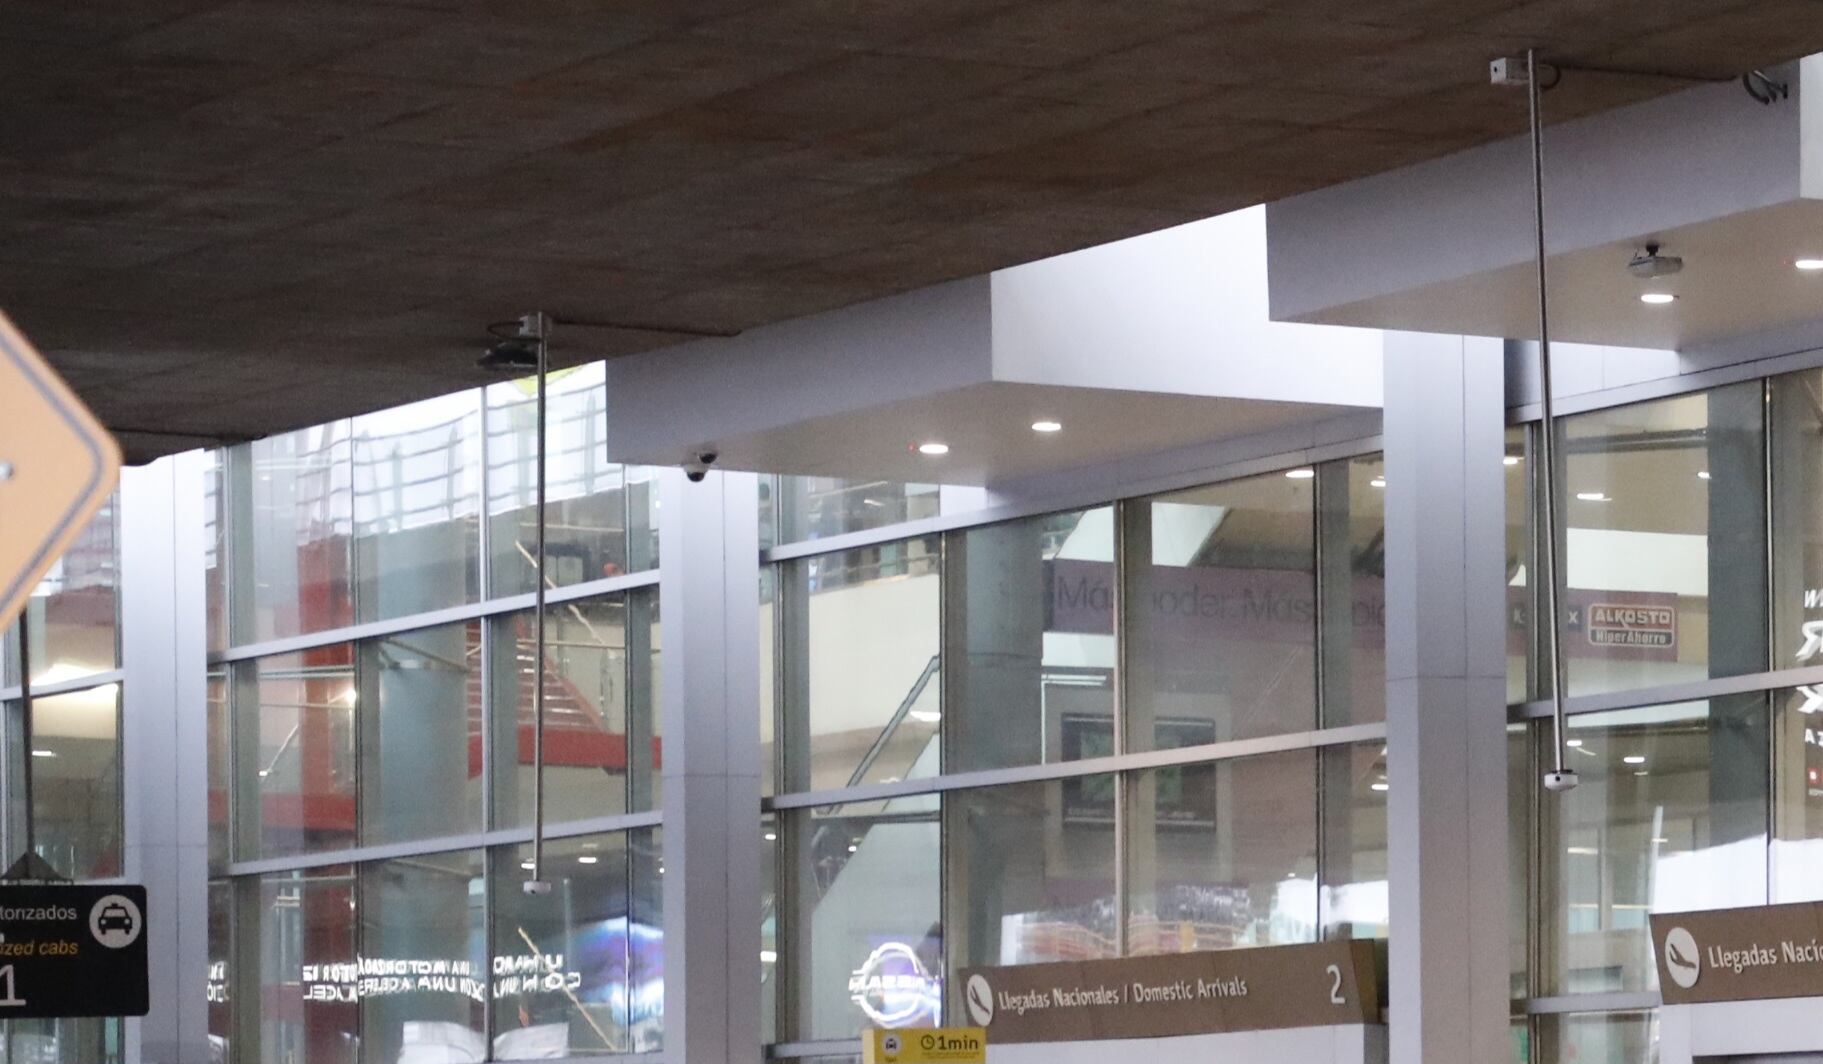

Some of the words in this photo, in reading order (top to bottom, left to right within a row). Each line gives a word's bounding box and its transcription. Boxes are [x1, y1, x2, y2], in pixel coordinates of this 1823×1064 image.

[1595, 609, 1671, 627] ALKOSTO
[38, 939, 79, 956] cabs
[1707, 944, 1778, 974] Llegadas
[1326, 963, 1346, 1005] 2
[998, 991, 1051, 1017] Llegadas
[1053, 986, 1120, 1006] Nacionales
[1133, 981, 1193, 1003] Domestic
[1197, 976, 1248, 998] Arrivals
[937, 1034, 979, 1051] 1min
